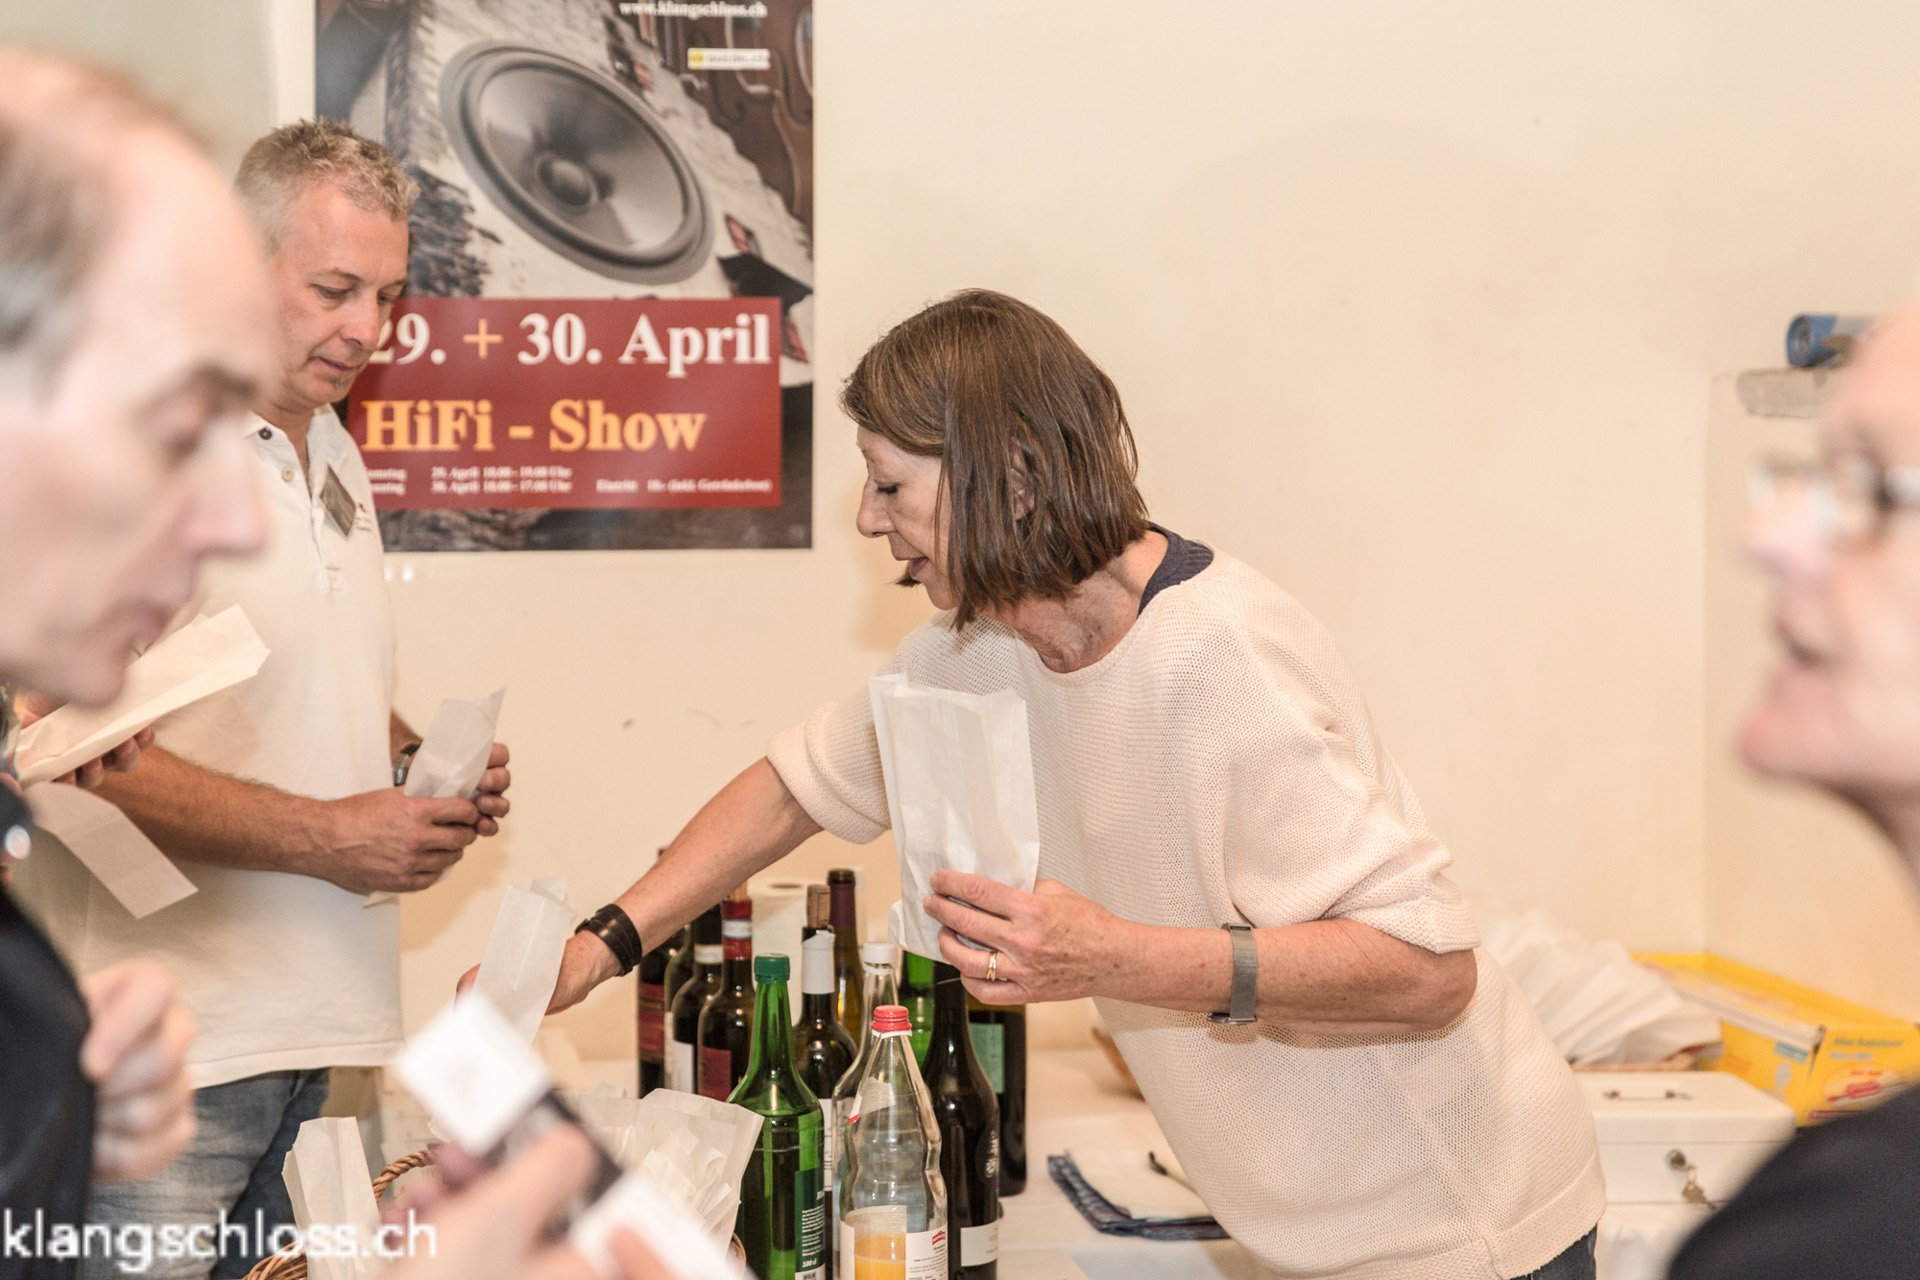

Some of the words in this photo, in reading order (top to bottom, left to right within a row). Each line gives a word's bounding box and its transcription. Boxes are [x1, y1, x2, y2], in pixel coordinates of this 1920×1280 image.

[619, 1, 768, 20] www.klangschloss.ch
[367, 312, 447, 365] 29.
[463, 318, 502, 358] +
[518, 312, 602, 365] 30.
[617, 312, 771, 379] April
[361, 398, 494, 452] HiFi
[508, 426, 535, 439] -
[549, 397, 707, 452] Show
